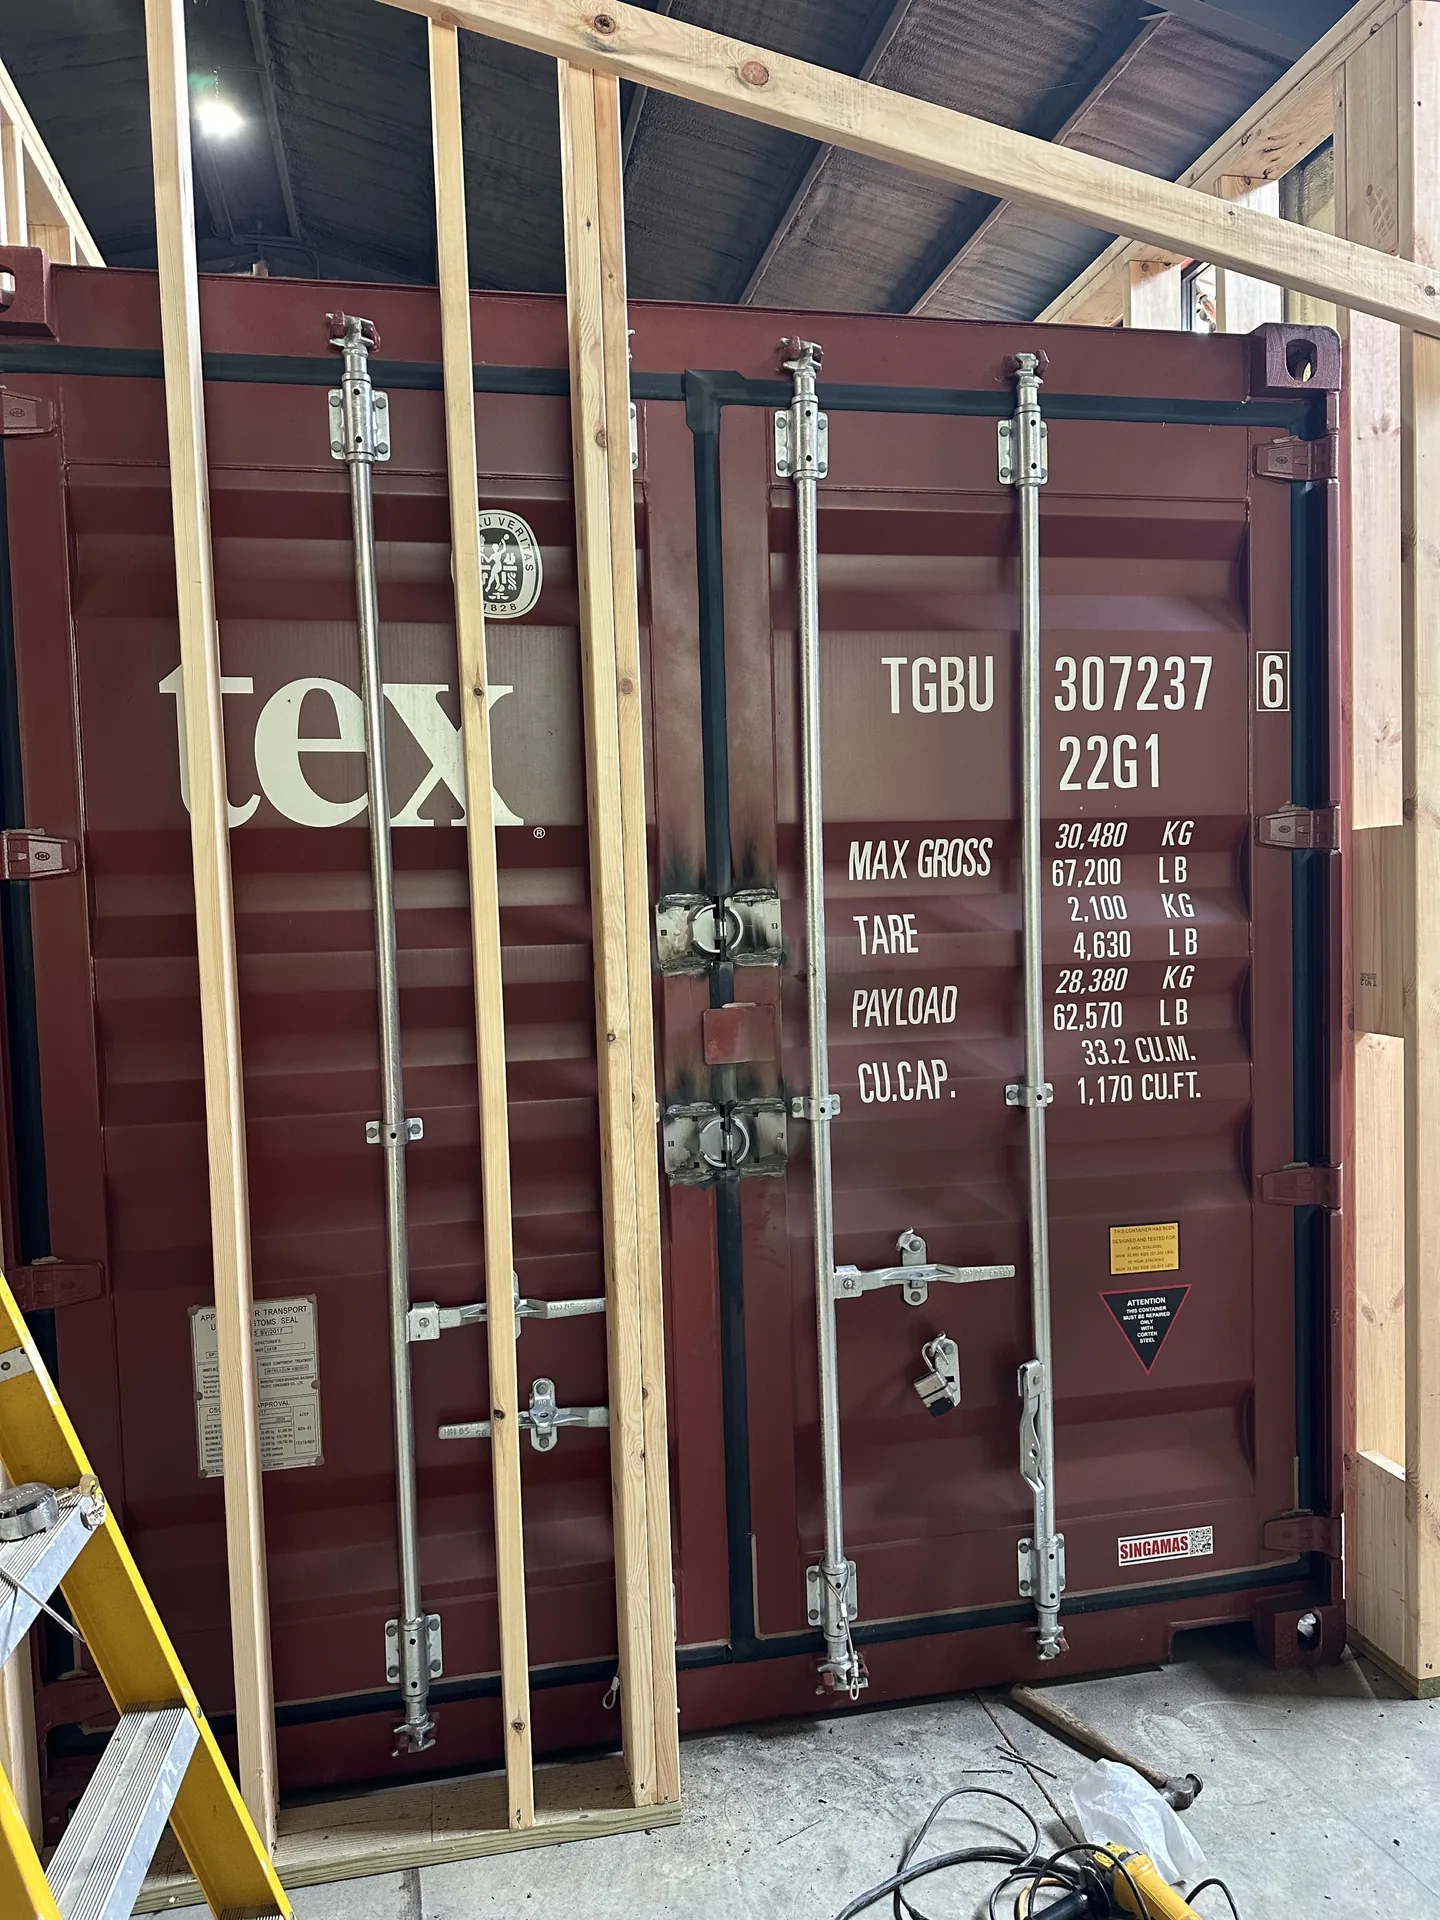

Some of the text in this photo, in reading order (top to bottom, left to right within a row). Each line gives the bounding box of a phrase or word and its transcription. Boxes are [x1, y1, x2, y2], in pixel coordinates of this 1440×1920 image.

[498, 517, 534, 572] VERITAS
[881, 655, 1284, 714] TGBU 307237 6
[1059, 734, 1161, 791] 22G1
[1055, 820, 1195, 851] 30,480 KG
[848, 837, 992, 881] MAX GROSS
[1052, 856, 1188, 888] 67,200 LB
[1067, 893, 1195, 923] 2,100 KG
[853, 914, 919, 956] TARE
[1073, 928, 1198, 960] 4,630 LB
[1055, 965, 1195, 997] 28,380 KG
[852, 985, 958, 1028] PAYLOAD
[1053, 999, 1189, 1032] 62,570 LB
[1081, 1036, 1196, 1066] 33.2 CU.M.
[858, 1058, 956, 1104] CU.CAP.
[1077, 1071, 1201, 1105] 1,170 CU.FT.
[264, 1305, 308, 1317] TRANSPORT
[1127, 1297, 1166, 1306] ATTENTION
[253, 1316, 299, 1327] STOMS SEAL
[1120, 1535, 1188, 1560] SINGAMAS
